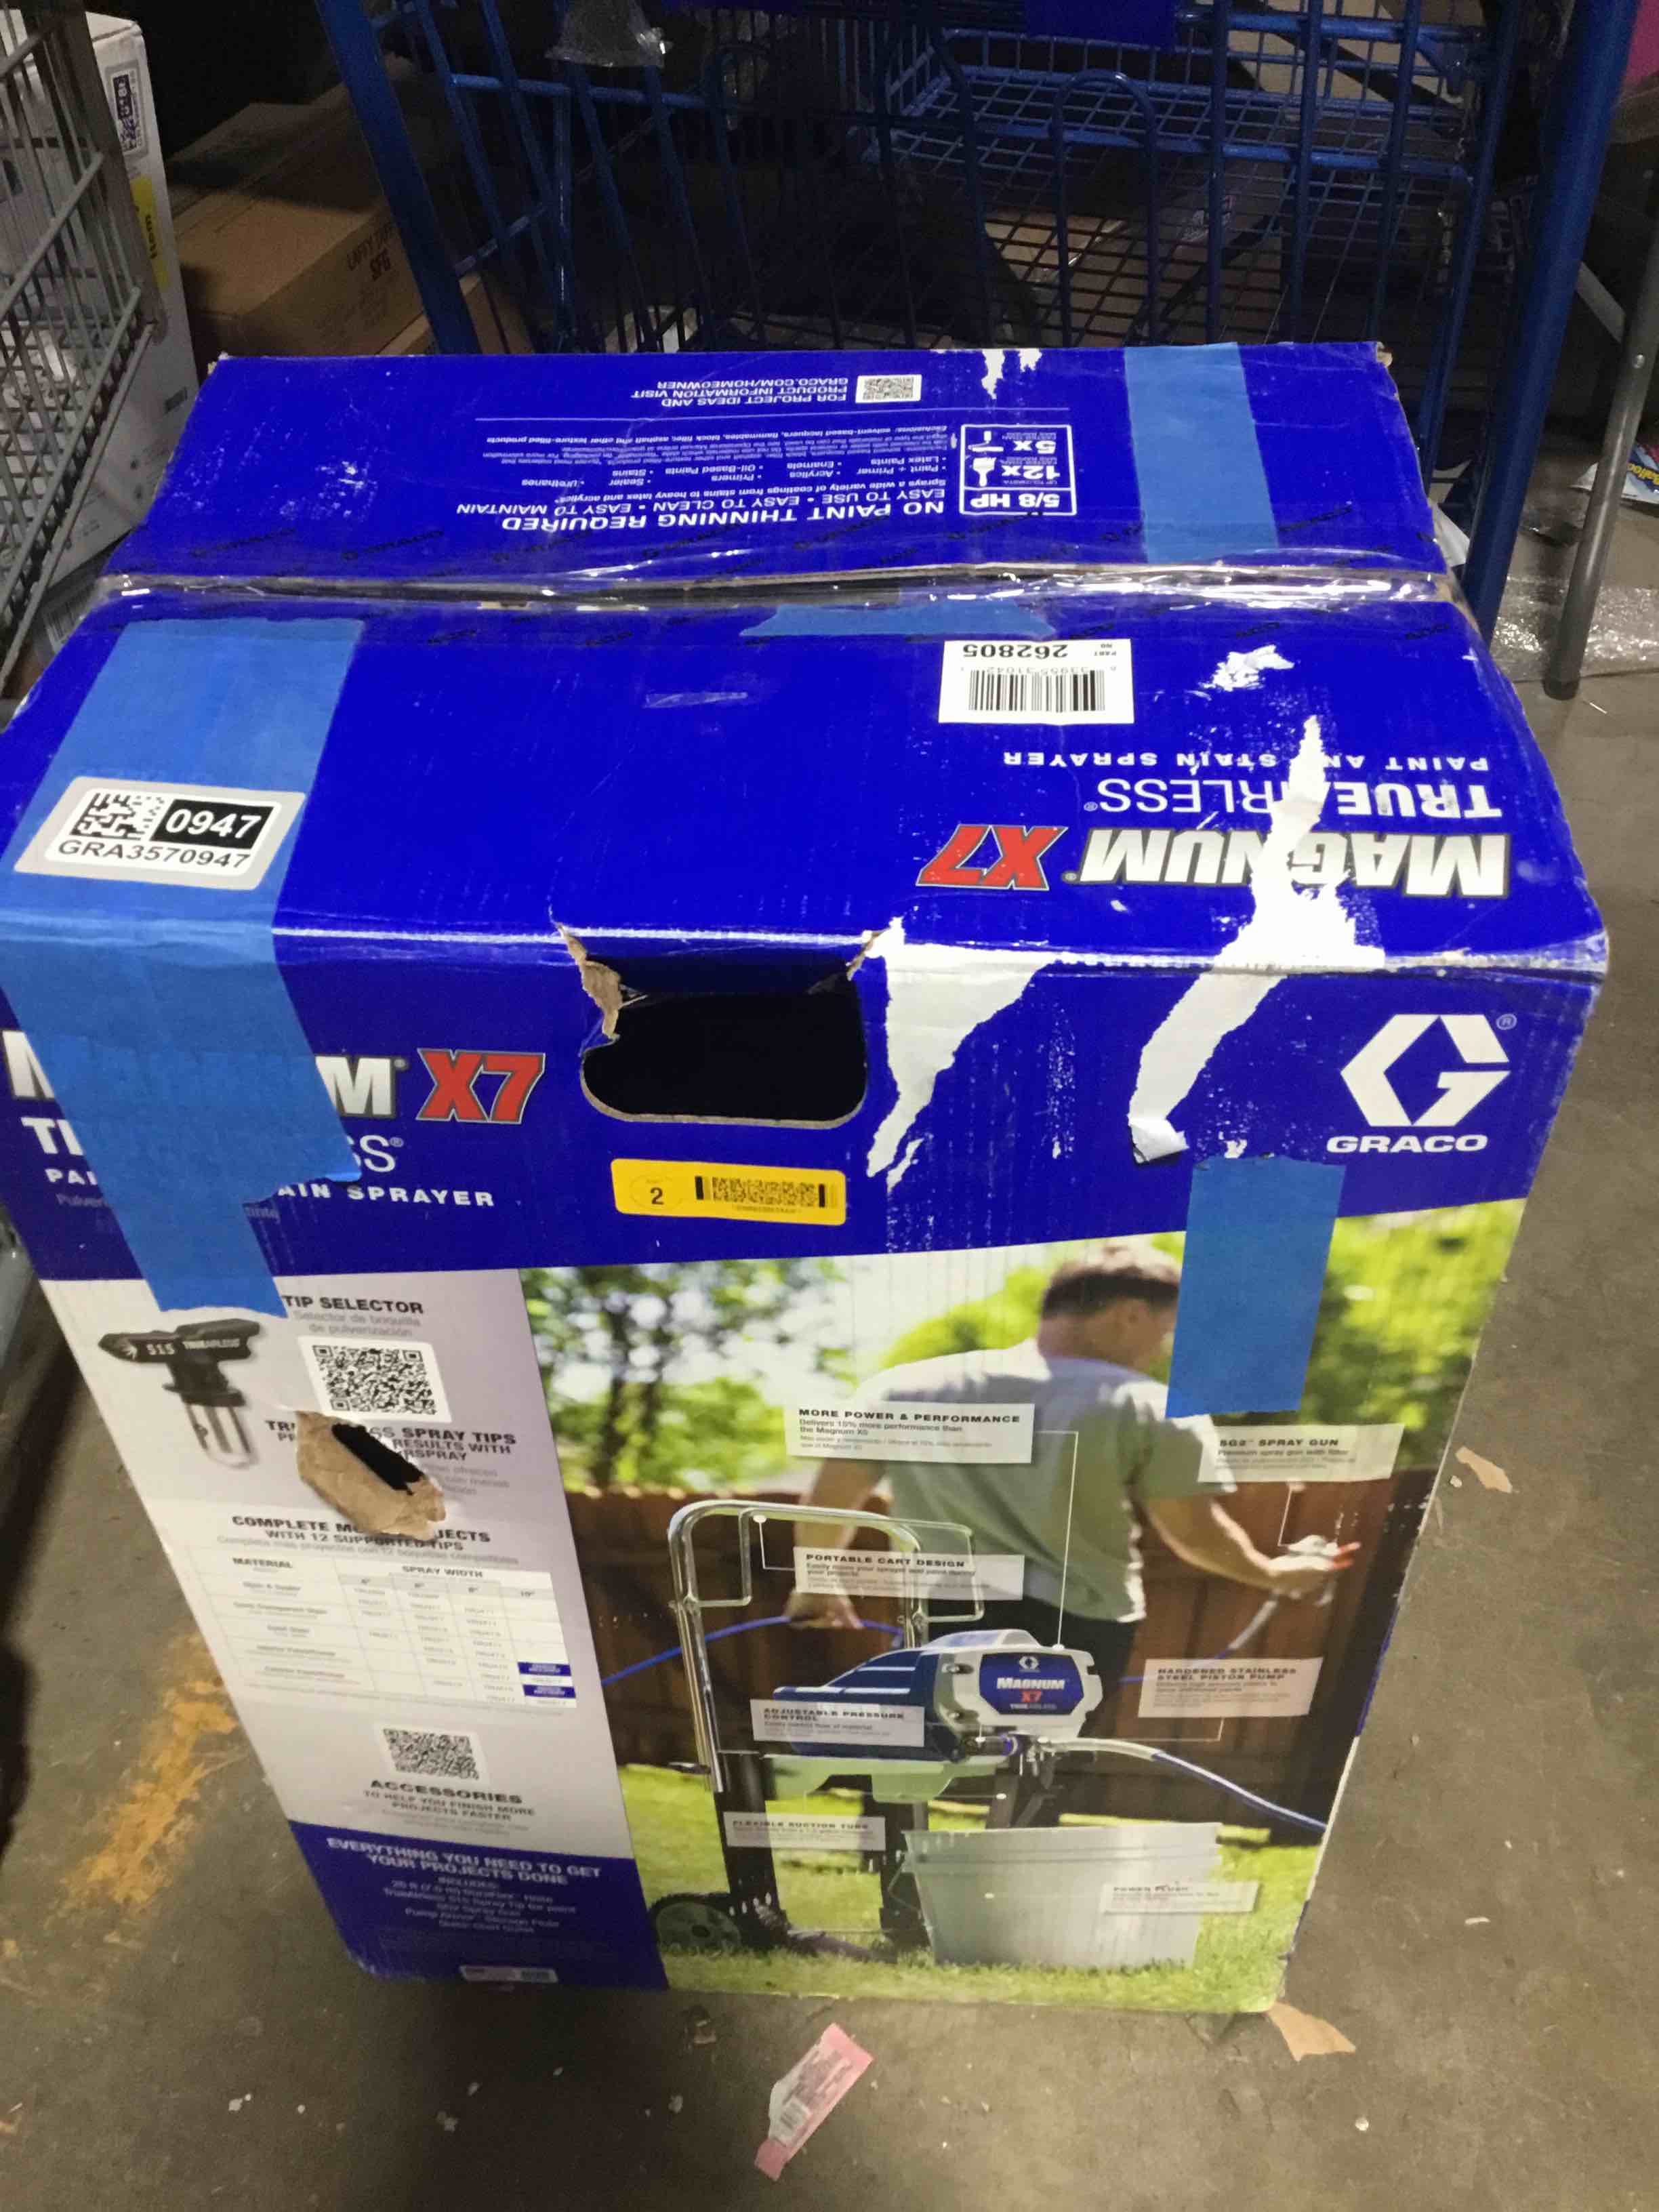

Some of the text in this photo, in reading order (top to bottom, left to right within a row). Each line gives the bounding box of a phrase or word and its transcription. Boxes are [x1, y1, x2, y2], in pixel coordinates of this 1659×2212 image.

[656, 376, 848, 389] GRACO.COM/HOMEOWNER
[630, 385, 847, 398] PRODUCT INFORMATION VISIT
[660, 393, 846, 407] FOR PROJECT IDEAS AND
[1012, 439, 1056, 453] 5x
[785, 460, 834, 468] Enamels
[869, 455, 939, 465] Latex Paints
[611, 468, 646, 476] Stains
[663, 464, 756, 474] Oil-Based Paints
[788, 469, 833, 478] Acrylics
[856, 466, 893, 475] Primer
[909, 464, 938, 472] Paint
[1000, 464, 1059, 479] 12x
[520, 478, 577, 487] Urethanes
[710, 473, 754, 481] Primers
[908, 478, 945, 487] Sprays
[766, 485, 812, 494] coatings
[830, 482, 866, 490] variety
[654, 490, 686, 499] heavy
[969, 491, 1059, 508] 5/8 HP
[455, 488, 945, 516] EASY TO USE EASY TO CLEAN EASY TO MAINTAIN
[501, 500, 943, 531] NO PAINT THINNING REQUIRED
[962, 644, 1067, 659] 262805
[1002, 751, 1488, 771] PAINT STAIN SPRAYER
[165, 808, 262, 839] 0947
[58, 839, 251, 868] GRA3570947
[914, 823, 1068, 890] X7
[415, 1048, 546, 1125] X7
[1326, 1134, 1488, 1153] GRACO
[347, 1186, 495, 1207] SPRAYER
[650, 1187, 664, 1205] 2
[282, 1295, 424, 1314] TIP SELECTOR
[798, 1409, 839, 1418] MORE
[844, 1411, 894, 1420] POWER
[914, 1414, 1020, 1423] PERFORMANCE
[402, 1427, 466, 1441] SPRAY
[472, 1431, 517, 1445] TIPS
[392, 1439, 512, 1454] RESULTS WITH
[232, 1515, 330, 1532] COMPLETE
[265, 1529, 305, 1540] WITH
[311, 1532, 329, 1542] 12
[429, 1540, 464, 1551] TIPS
[232, 1557, 293, 1569] MATERIAL
[806, 1554, 872, 1563] PORTABLE
[403, 1565, 483, 1578] SPRAY WIDTH
[997, 1677, 1065, 1689] MAGNUM
[764, 1708, 904, 1719] ADJUSTABLE PRESSURE
[371, 1780, 523, 1804] ACCESSORIES
[462, 1809, 511, 1822] FASTER
[497, 1806, 535, 1816] MORE
[326, 1837, 601, 1878] EVERYTHING YOU NEED TO GET
[366, 1853, 569, 1885] YOUR PROJECTS DONE
